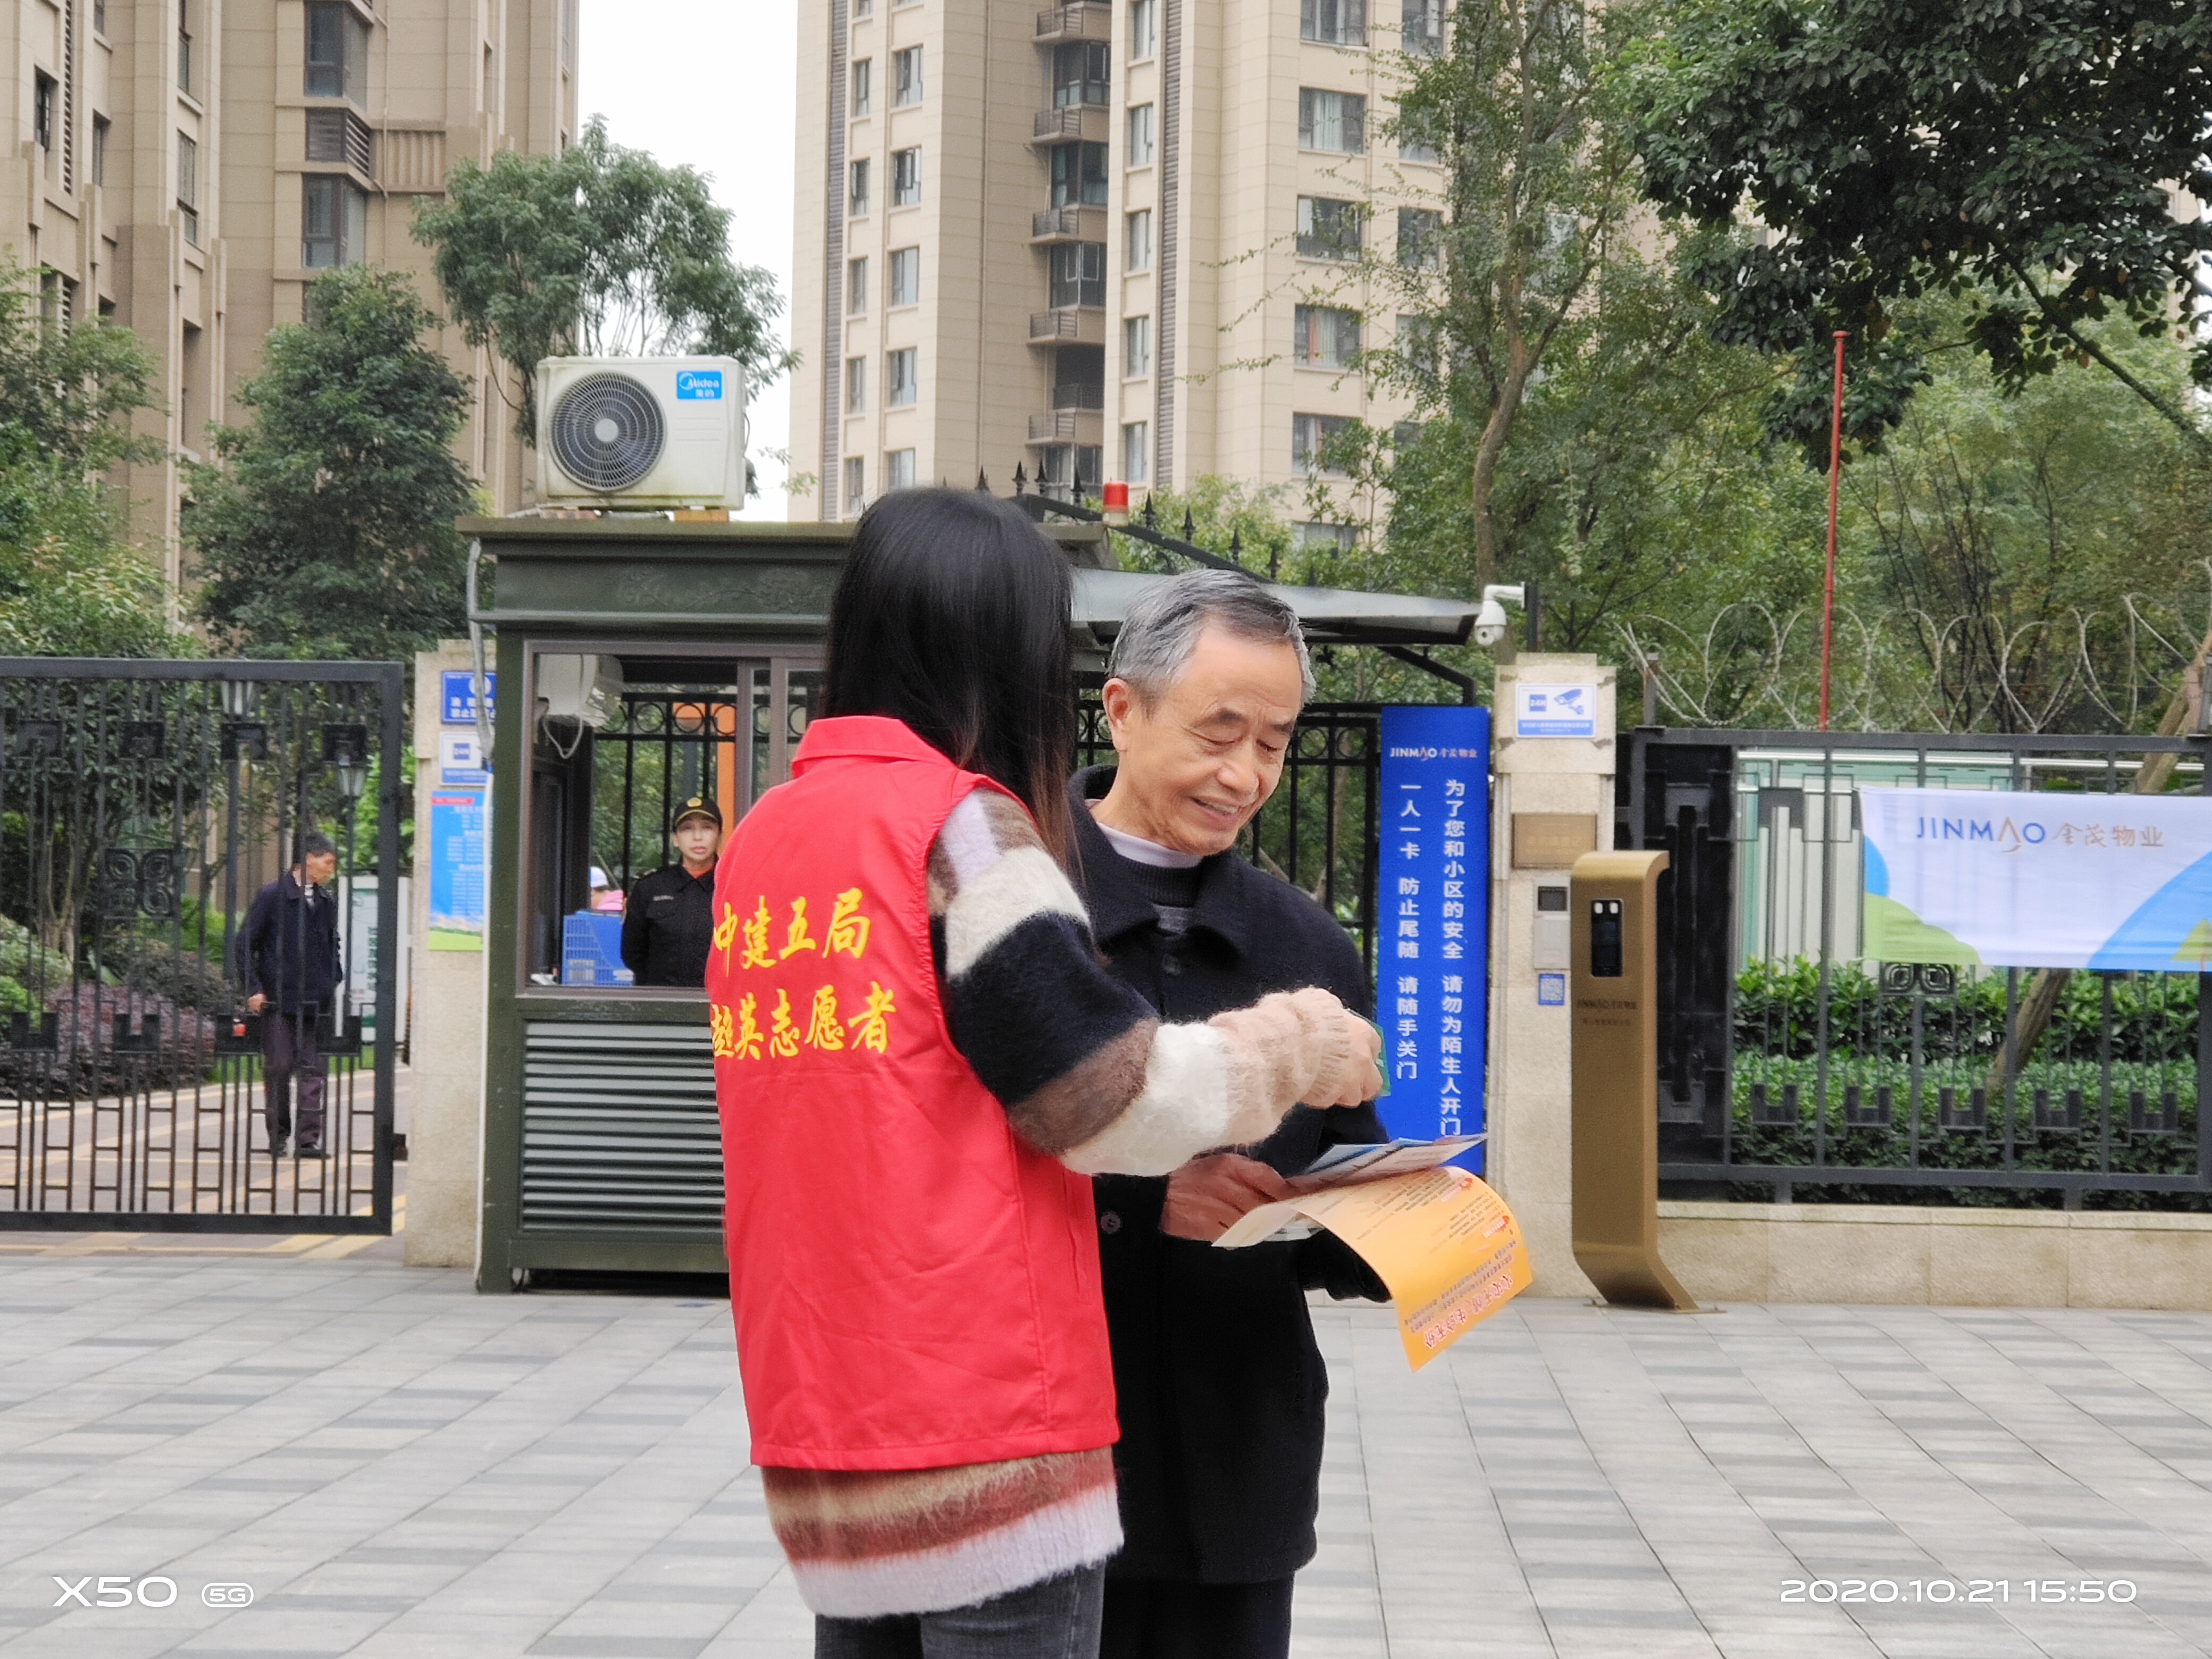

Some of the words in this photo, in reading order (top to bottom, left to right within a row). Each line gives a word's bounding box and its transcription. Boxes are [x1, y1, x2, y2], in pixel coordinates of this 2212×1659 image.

[686, 375, 719, 389] Midea
[1390, 747, 1438, 761] JINMAO
[1400, 785, 1421, 859] 一人一卡
[1916, 816, 2046, 852] JINMAO
[2052, 823, 2163, 848] 金茂物业
[1442, 779, 1465, 959] 为了您和小区的安全
[714, 887, 870, 977] 中建五局
[1397, 877, 1420, 959] 防止尾随
[1396, 976, 1418, 1080] 请随手关门
[1440, 975, 1463, 1137] 请勿为陌生人开门
